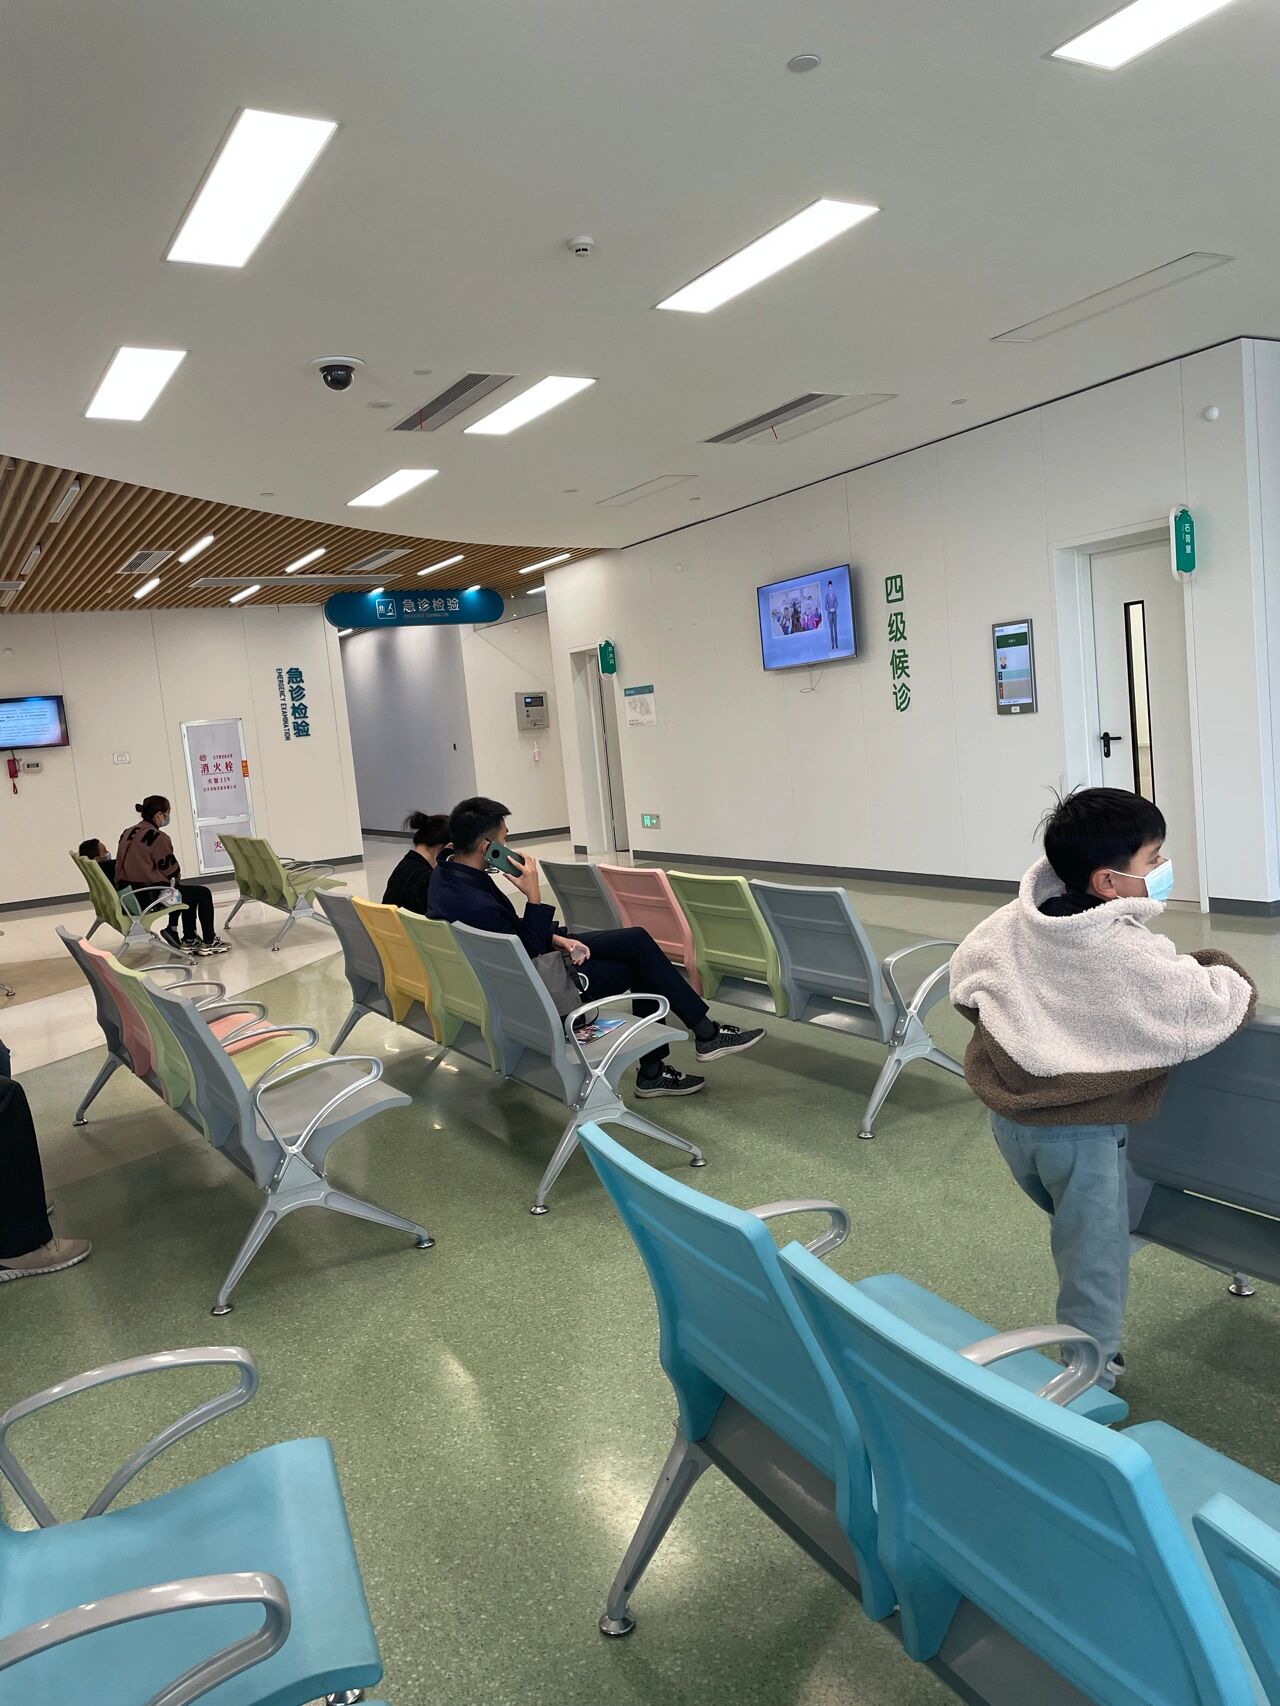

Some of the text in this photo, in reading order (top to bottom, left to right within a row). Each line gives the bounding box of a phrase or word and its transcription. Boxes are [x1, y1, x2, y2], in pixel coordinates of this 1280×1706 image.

[402, 597, 461, 613] 急诊检验
[884, 574, 911, 712] 四级候诊
[275, 668, 291, 741] EMERGENCY EXAMINATION
[286, 667, 311, 738] 急诊检验
[200, 761, 233, 774] 消火栓
